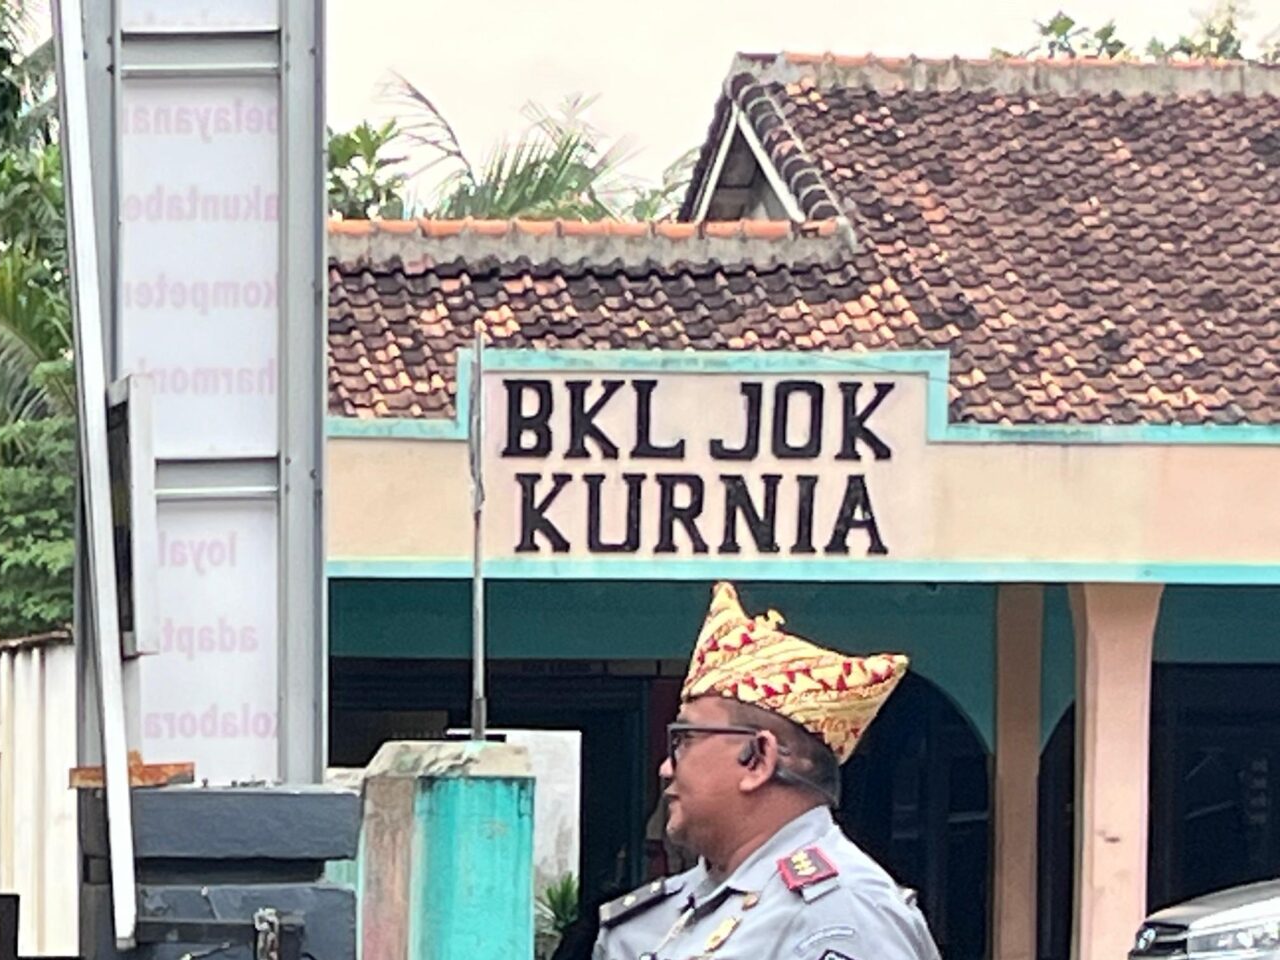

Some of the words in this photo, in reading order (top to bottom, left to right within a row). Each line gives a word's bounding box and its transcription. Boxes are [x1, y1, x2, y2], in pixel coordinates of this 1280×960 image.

[501, 378, 686, 460] BKL
[709, 379, 896, 461] JOK
[513, 472, 890, 556] KURNIA
